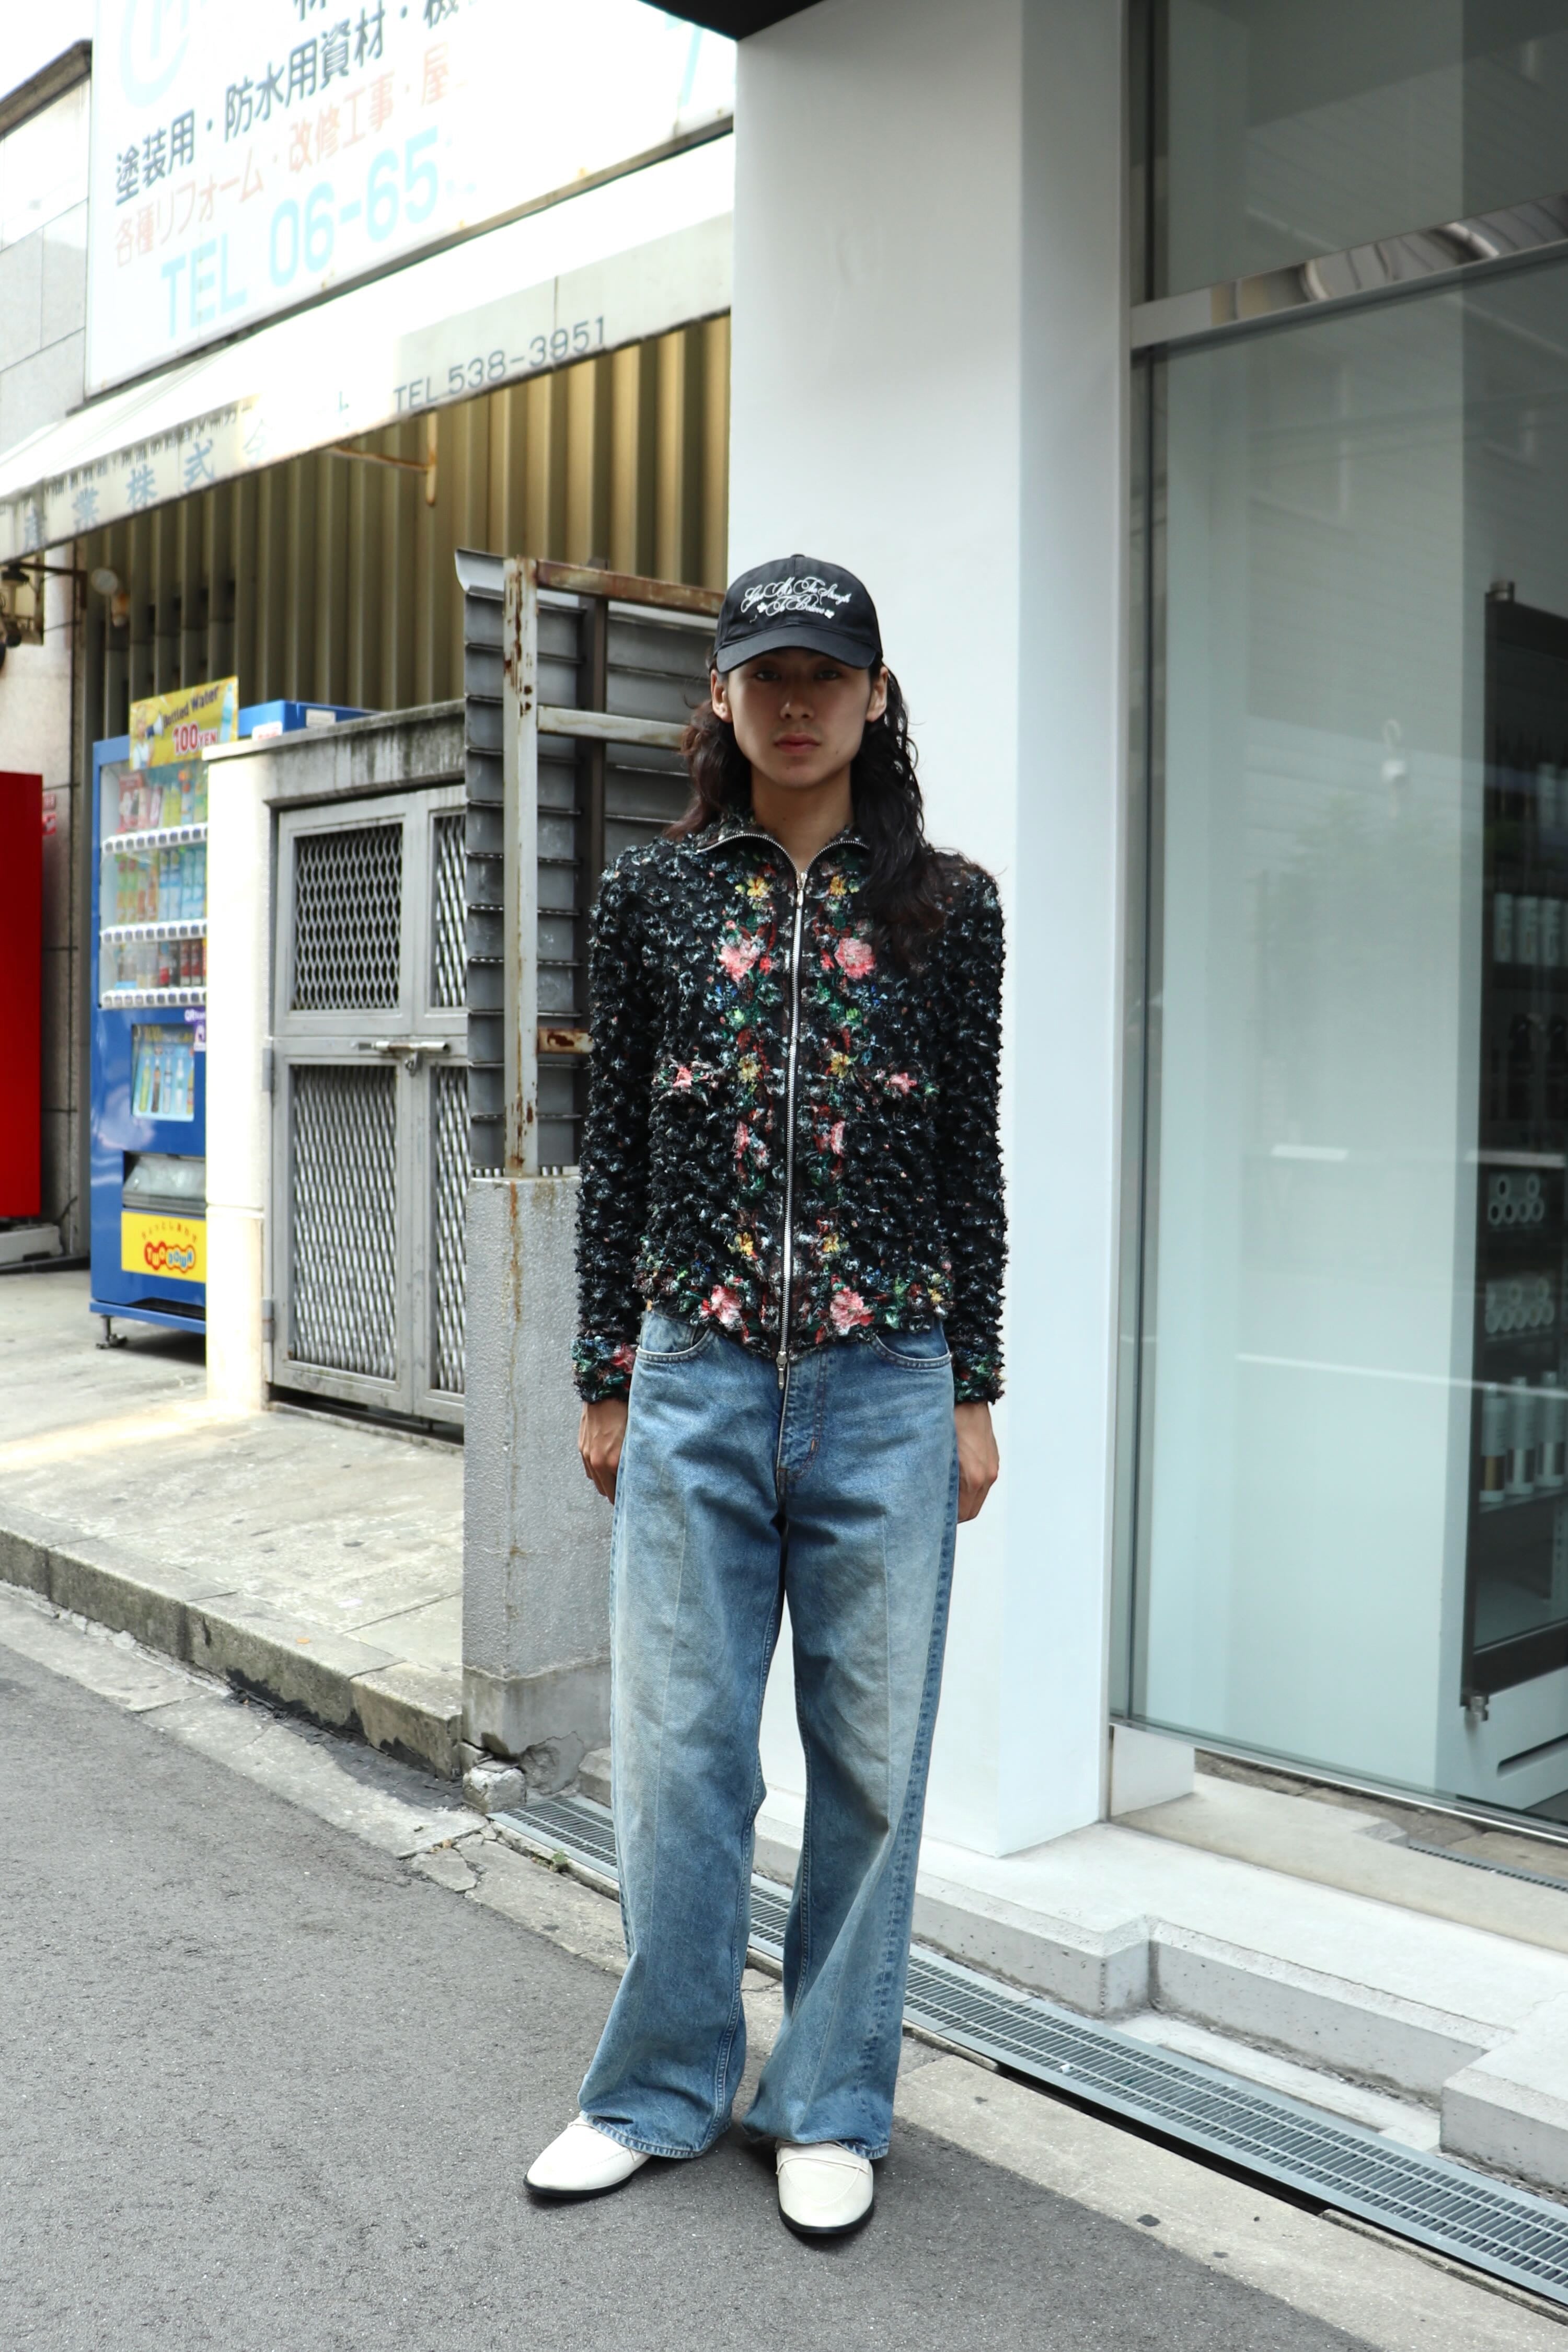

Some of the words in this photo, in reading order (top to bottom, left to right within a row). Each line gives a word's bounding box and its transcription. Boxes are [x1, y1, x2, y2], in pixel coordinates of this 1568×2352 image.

[114, 42, 467, 268] 各種リフォーム・改修工事・屋
[160, 232, 247, 339] TEL
[268, 125, 440, 289] 06-65
[394, 377, 438, 413] TEL
[447, 316, 605, 396] 538-3951
